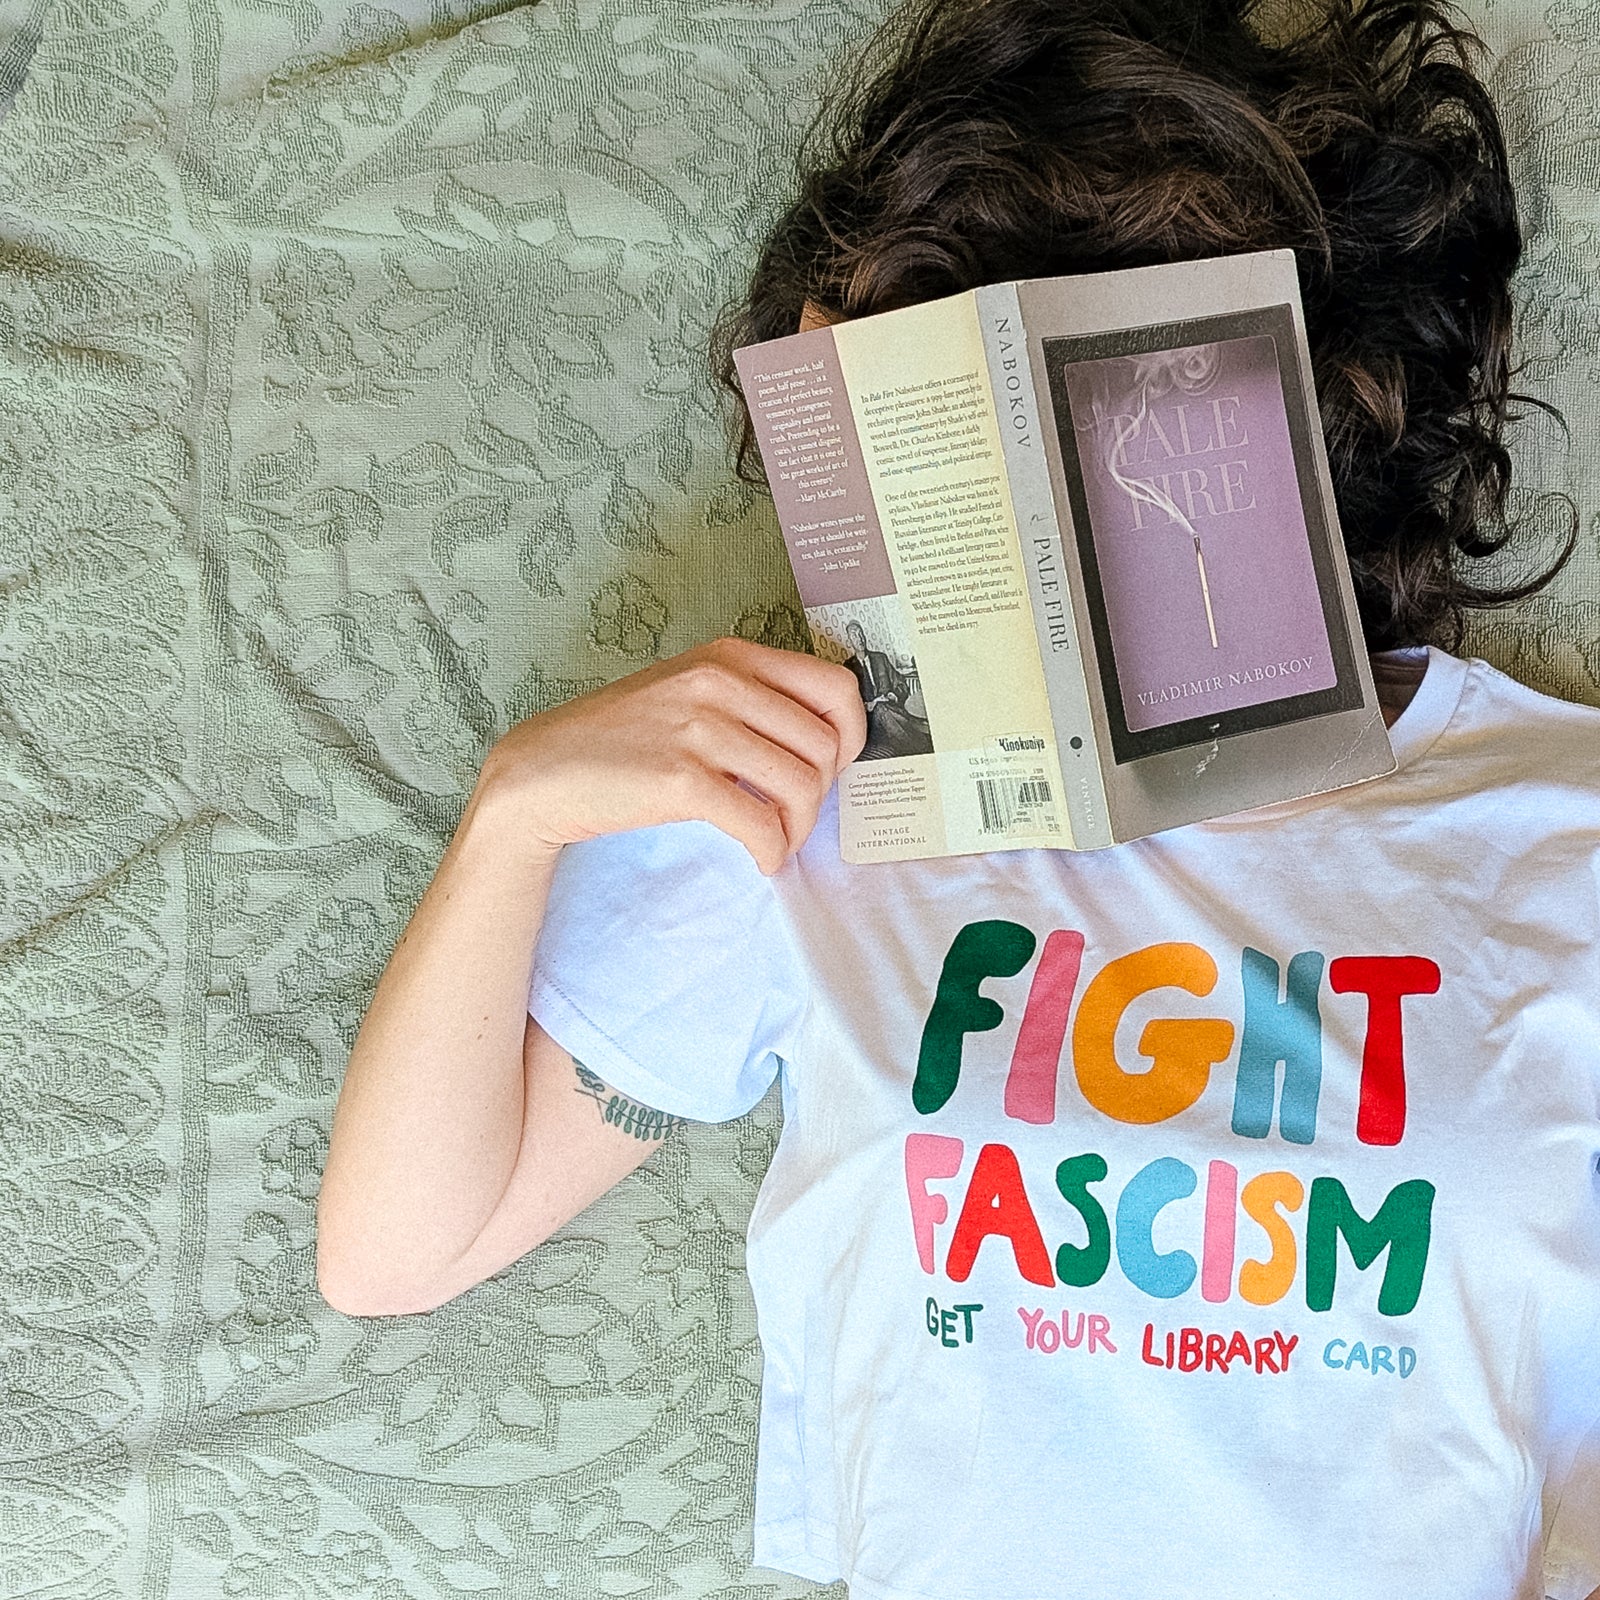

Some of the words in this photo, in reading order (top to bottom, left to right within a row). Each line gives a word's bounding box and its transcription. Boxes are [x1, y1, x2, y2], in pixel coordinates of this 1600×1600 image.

[754, 373, 771, 383] "This
[794, 364, 812, 374] work,
[811, 359, 824, 370] half
[758, 387, 777, 398] poem,
[777, 381, 789, 391] half
[790, 380, 806, 390] prose
[894, 384, 924, 396] Nabokov
[995, 317, 1031, 447] NABOKOV
[758, 399, 783, 408] creation
[790, 390, 811, 404] perfect
[811, 387, 833, 396] beauty,
[864, 404, 894, 416] deceptive
[772, 419, 801, 431] originality
[803, 415, 813, 424] and
[814, 411, 831, 422] moral
[867, 417, 894, 429] reclusive
[895, 413, 916, 425] genius
[916, 409, 931, 420] John
[787, 428, 820, 441] Pretending
[827, 424, 835, 432] be
[870, 431, 887, 440] word
[887, 428, 900, 438] and
[900, 421, 939, 435] commentary
[1106, 396, 1249, 467] PALE
[798, 441, 818, 451] cannot
[911, 434, 936, 445] Charles
[778, 459, 788, 467] the
[789, 457, 800, 465] fact
[801, 455, 813, 463] that
[896, 451, 914, 462] novel
[780, 471, 790, 480] the
[791, 469, 805, 480] great
[806, 465, 824, 474] works
[798, 480, 810, 489] this
[817, 487, 846, 499] McCarthy
[884, 494, 899, 503] One
[908, 489, 918, 498] the
[919, 483, 949, 496] twentieth
[939, 494, 966, 505] Nabokov
[1131, 460, 1257, 532] FIRE
[838, 517, 854, 527] prose
[855, 513, 865, 522] the
[795, 538, 807, 547] only
[808, 538, 819, 546] way
[826, 530, 845, 541] should
[845, 530, 853, 538] be
[919, 539, 934, 547] then
[934, 534, 950, 545] lived
[813, 550, 826, 558] that
[899, 556, 908, 564] he
[838, 559, 860, 570] Updike
[918, 565, 927, 573] he
[928, 560, 949, 571] moved
[956, 558, 966, 566] the
[1033, 537, 1058, 594] PALE
[938, 610, 959, 620] moved
[1044, 599, 1070, 653] FIRE
[1137, 677, 1224, 706] VLADIMIR
[1228, 657, 1313, 688] NABOKOV
[1080, 777, 1096, 829] VINTAGE
[872, 826, 910, 836] VINTAGE
[857, 836, 927, 849] INTERNATIONAL
[912, 919, 1441, 1146] FIGHT
[905, 1133, 1436, 1316] FASCISM
[926, 1297, 983, 1349] GET
[1017, 1306, 1117, 1353] YOUR
[1142, 1323, 1299, 1374] LIBRARY
[1323, 1338, 1416, 1379] CARD
